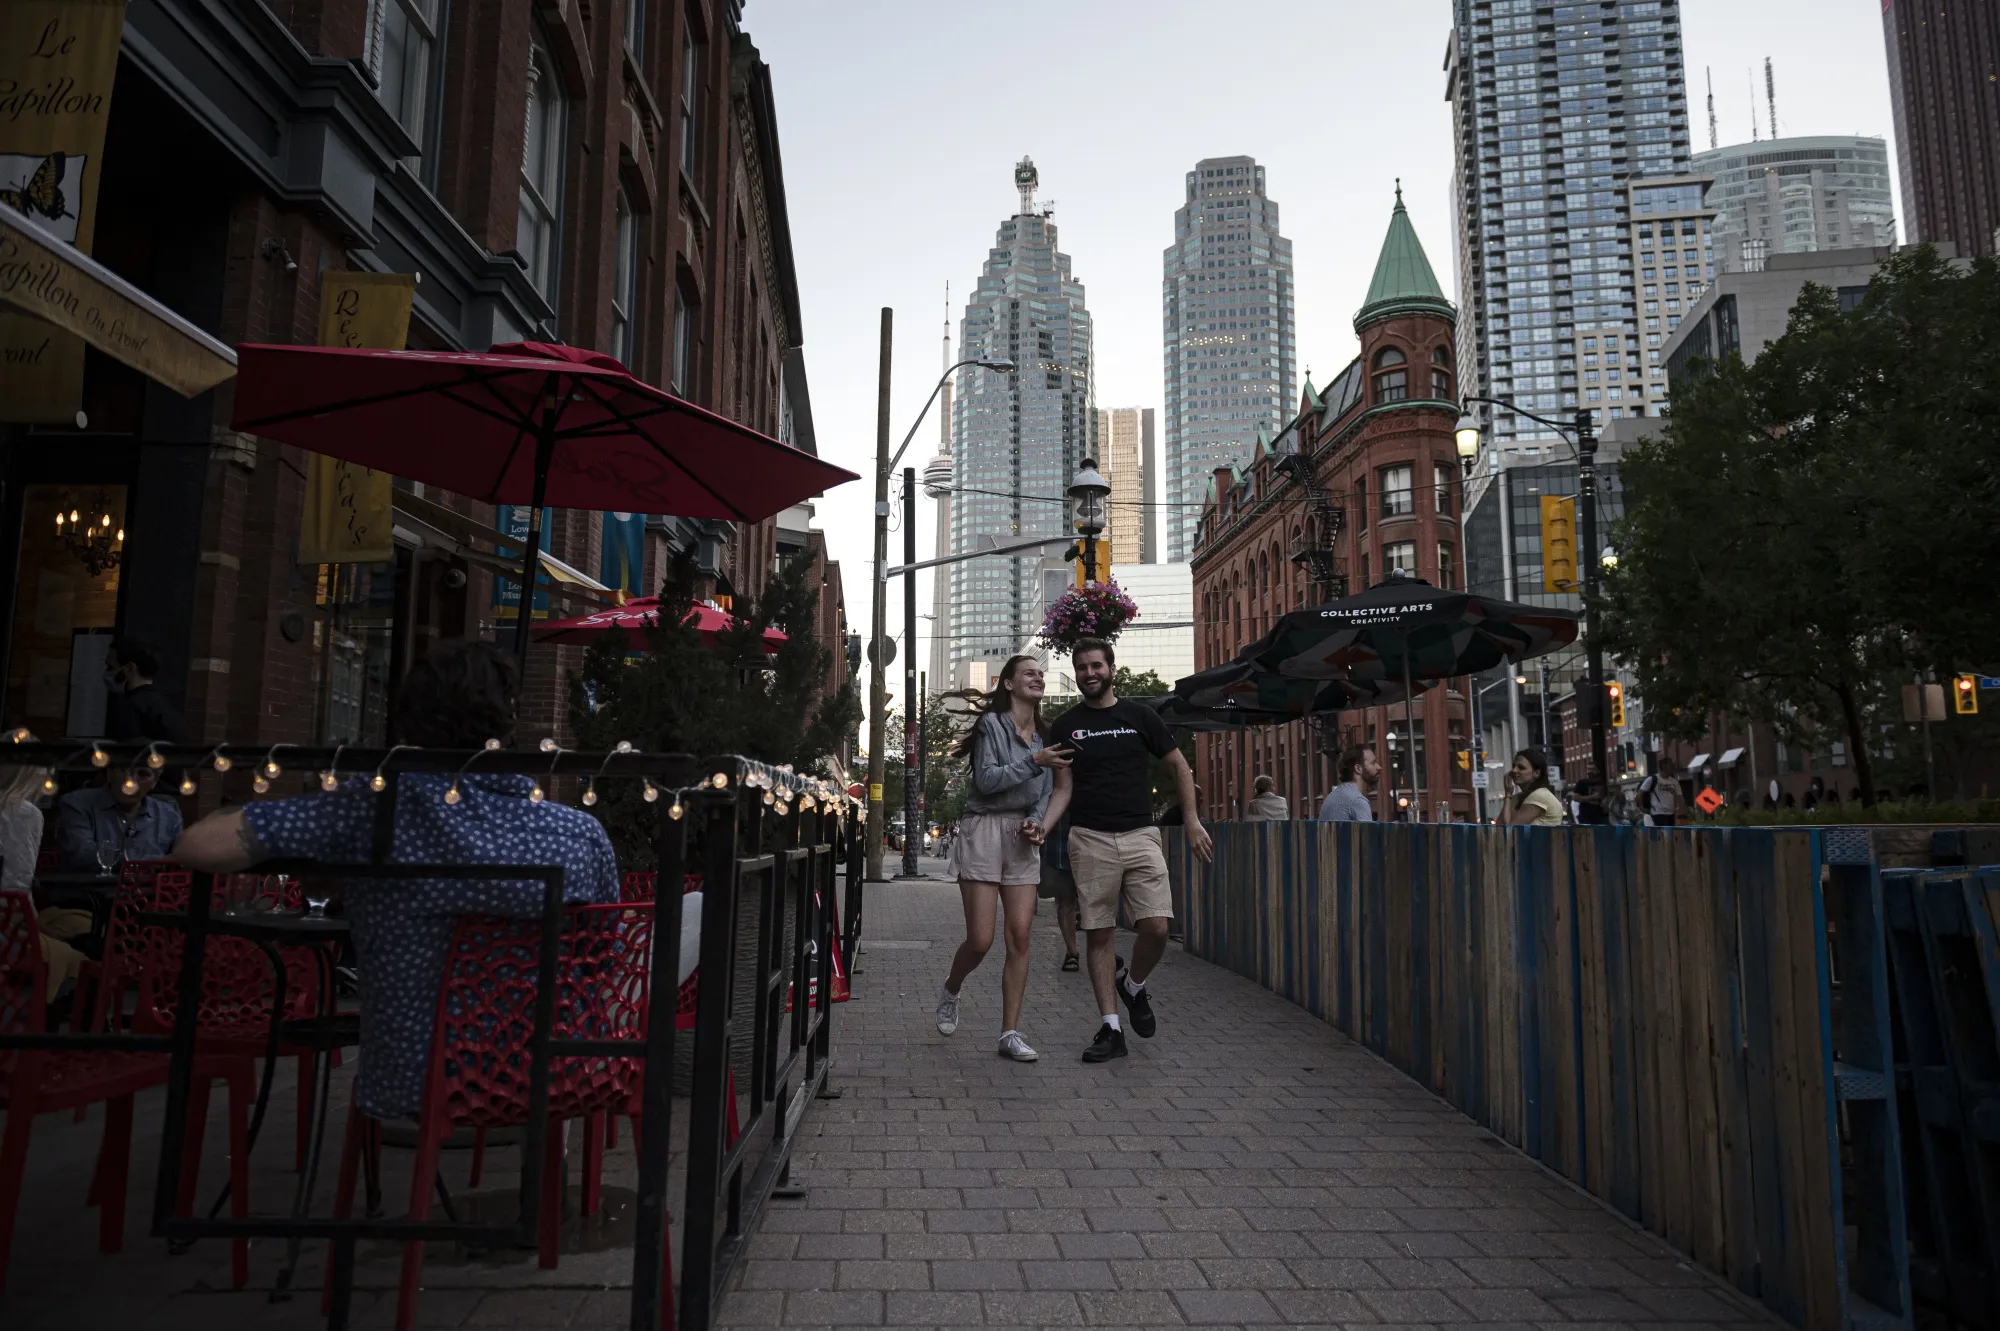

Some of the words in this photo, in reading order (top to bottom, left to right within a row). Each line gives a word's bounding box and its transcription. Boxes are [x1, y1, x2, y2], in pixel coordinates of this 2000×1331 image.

[29, 18, 76, 58] Le
[86, 305, 105, 332] On
[109, 318, 149, 353] Front
[4, 337, 51, 365] ront
[1320, 606, 1397, 618] COLLECTIVE
[1400, 603, 1433, 613] ARTS
[1350, 616, 1401, 625] CREATIVITY
[1072, 727, 1137, 740] Champion
